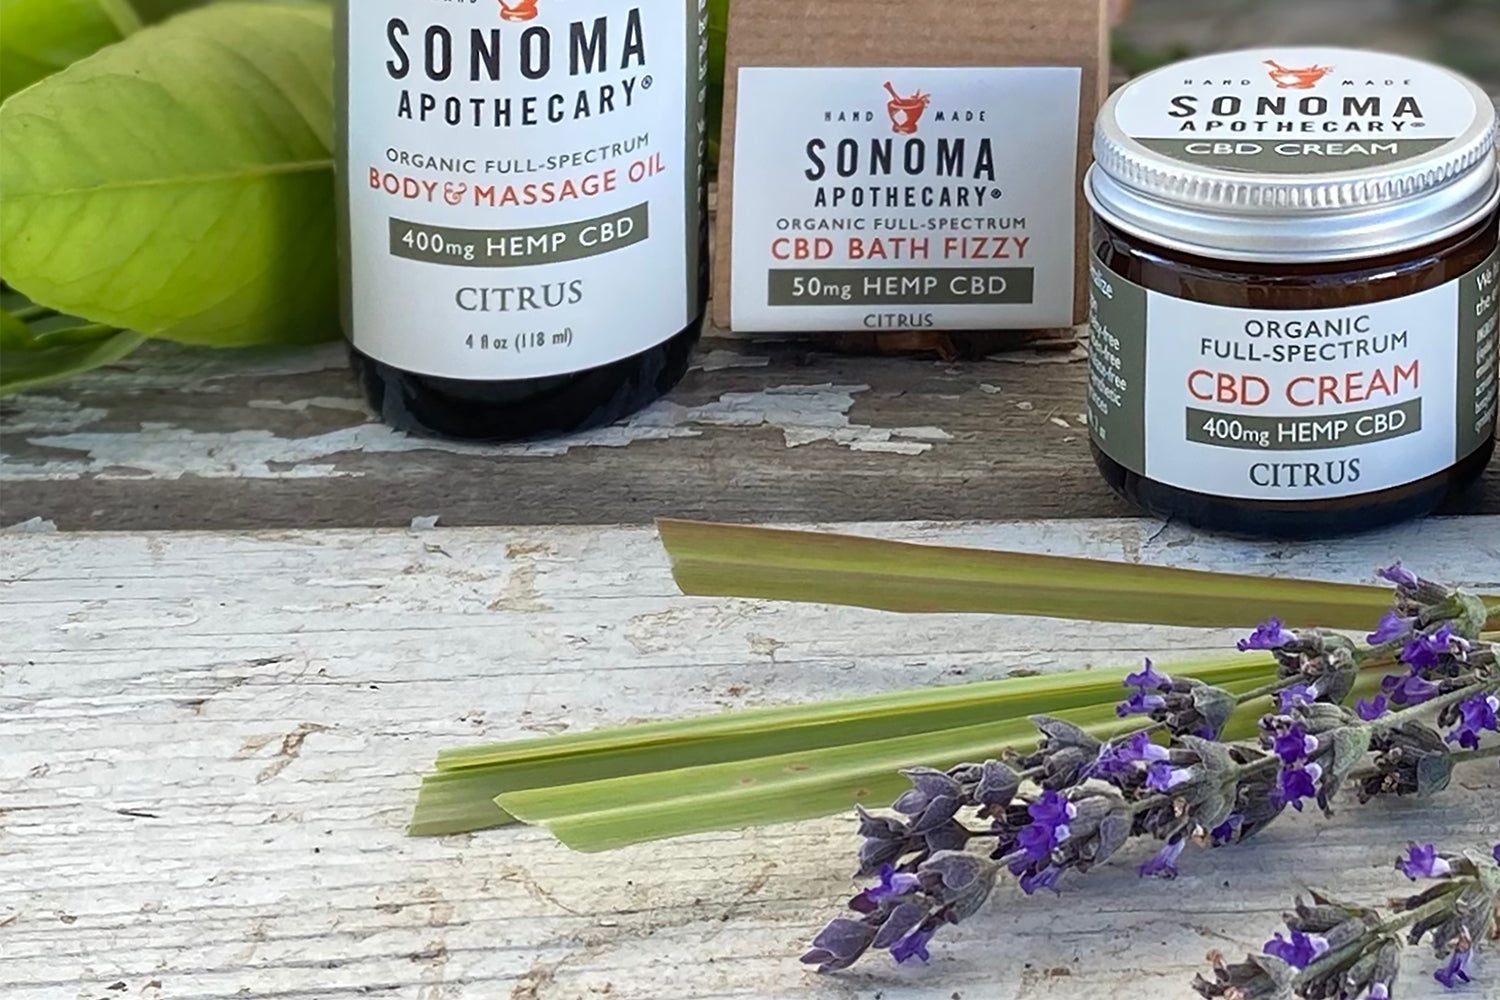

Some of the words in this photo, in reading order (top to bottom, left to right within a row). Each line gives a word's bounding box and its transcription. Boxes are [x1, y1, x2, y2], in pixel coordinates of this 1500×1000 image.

[386, 7, 647, 82] SONOMA
[1342, 78, 1412, 87] MADE
[397, 73, 654, 127] APOTHECARY®
[1167, 95, 1424, 119] SONOMA
[934, 110, 986, 123] MADE
[386, 147, 476, 174] ORGANIC
[485, 132, 649, 174] FULL-SPECTRUM
[804, 137, 996, 182] SONOMA
[1185, 143, 1263, 157] CBD
[1274, 143, 1398, 157] CREAM
[368, 167, 438, 202] BODY
[443, 183, 467, 205] &
[474, 171, 616, 207] MASSAGE
[628, 152, 666, 184] OIL
[814, 186, 1002, 208] APOTHECARY®
[776, 217, 866, 231] ORGANIC
[873, 217, 1026, 231] FULL-SPECTRUM
[401, 229, 475, 261] 400mg
[486, 232, 567, 257] HEMP
[579, 217, 634, 248] CBD
[771, 237, 833, 261] CBD
[848, 237, 929, 261] BATH
[944, 237, 1030, 260] FIZZY
[454, 279, 584, 312] CITRUS
[791, 276, 852, 300] 50mg
[863, 276, 938, 296] HEMP
[950, 276, 1007, 295] CBD
[863, 313, 934, 329] CITRUS
[1244, 314, 1370, 339] ORGANIC
[466, 334, 474, 348] 4
[493, 337, 508, 349] oz
[514, 330, 545, 351] (118
[552, 327, 573, 347] ml)
[1200, 330, 1408, 363] FULL-SPECTRUM
[1187, 369, 1270, 407] CBD
[1285, 359, 1420, 407] CREAM
[1202, 416, 1270, 447] 400mg
[1277, 420, 1348, 444] HEMP
[1355, 410, 1406, 437] CBD
[1249, 458, 1361, 488] CITRUS
